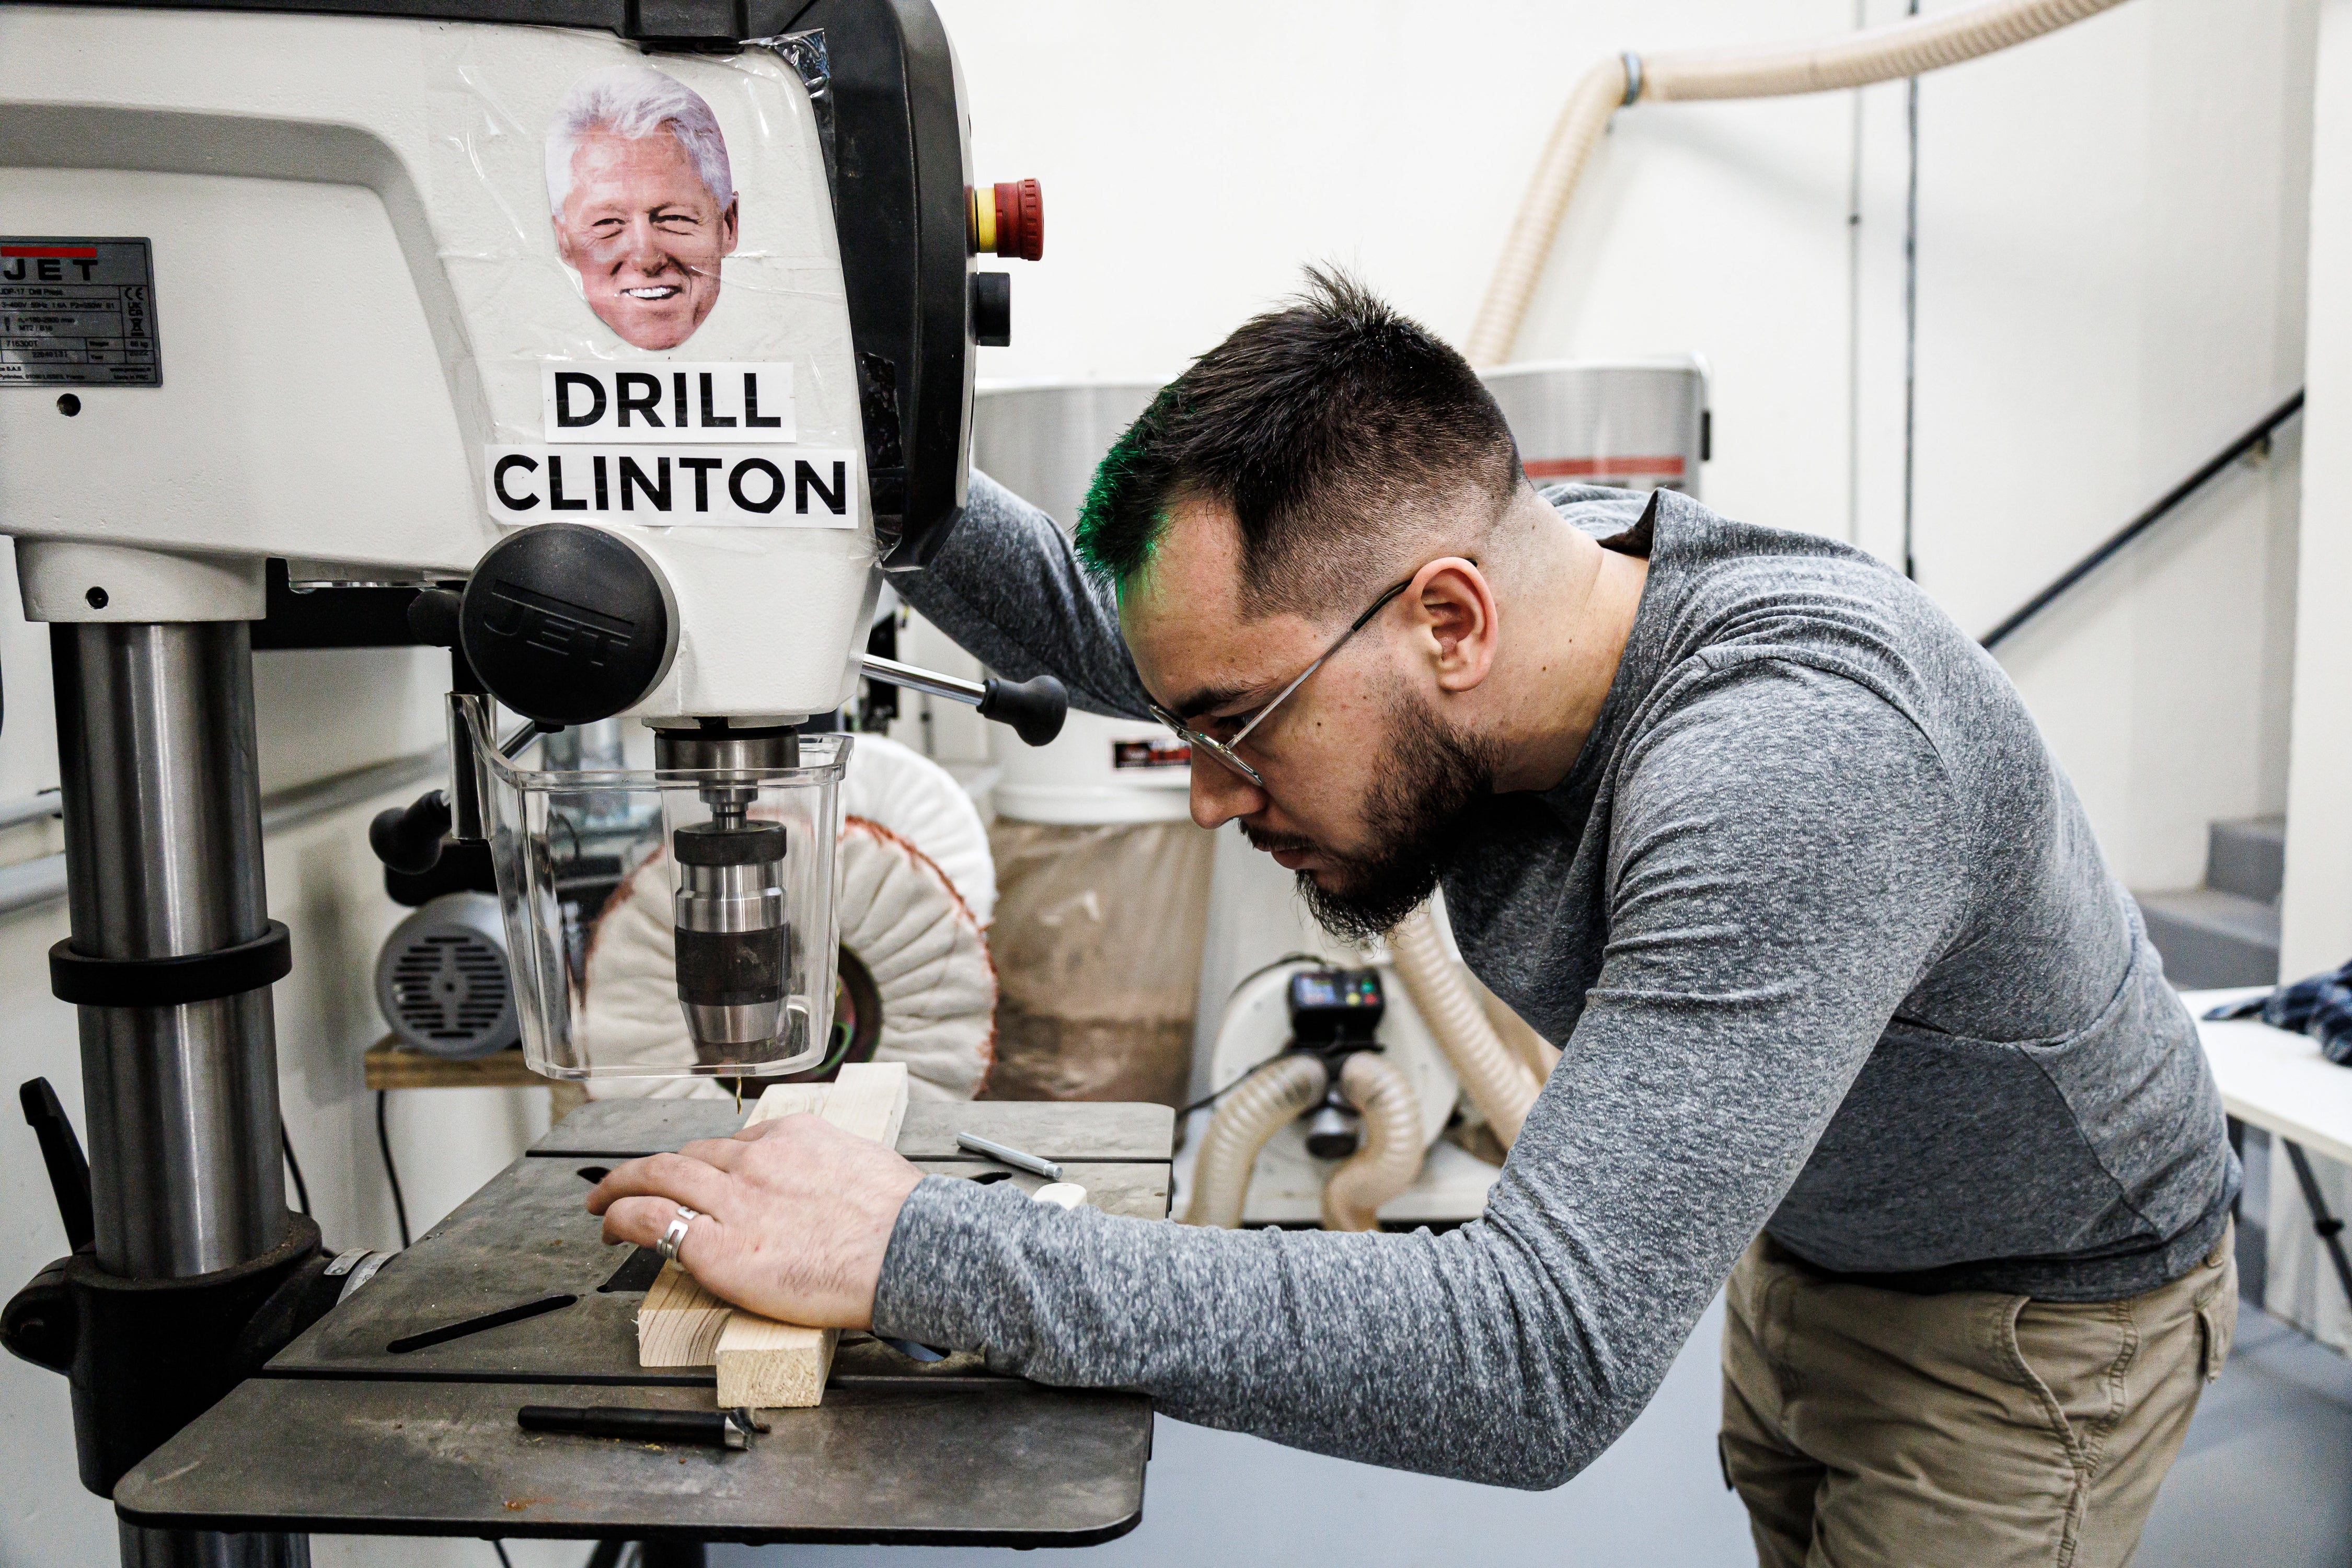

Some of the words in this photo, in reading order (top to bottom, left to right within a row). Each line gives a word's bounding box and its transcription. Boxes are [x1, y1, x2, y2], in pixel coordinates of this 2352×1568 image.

[3, 259, 98, 281] JET
[555, 372, 781, 428] DRILL
[493, 454, 846, 515] CLINTON
[482, 601, 629, 666] JET
